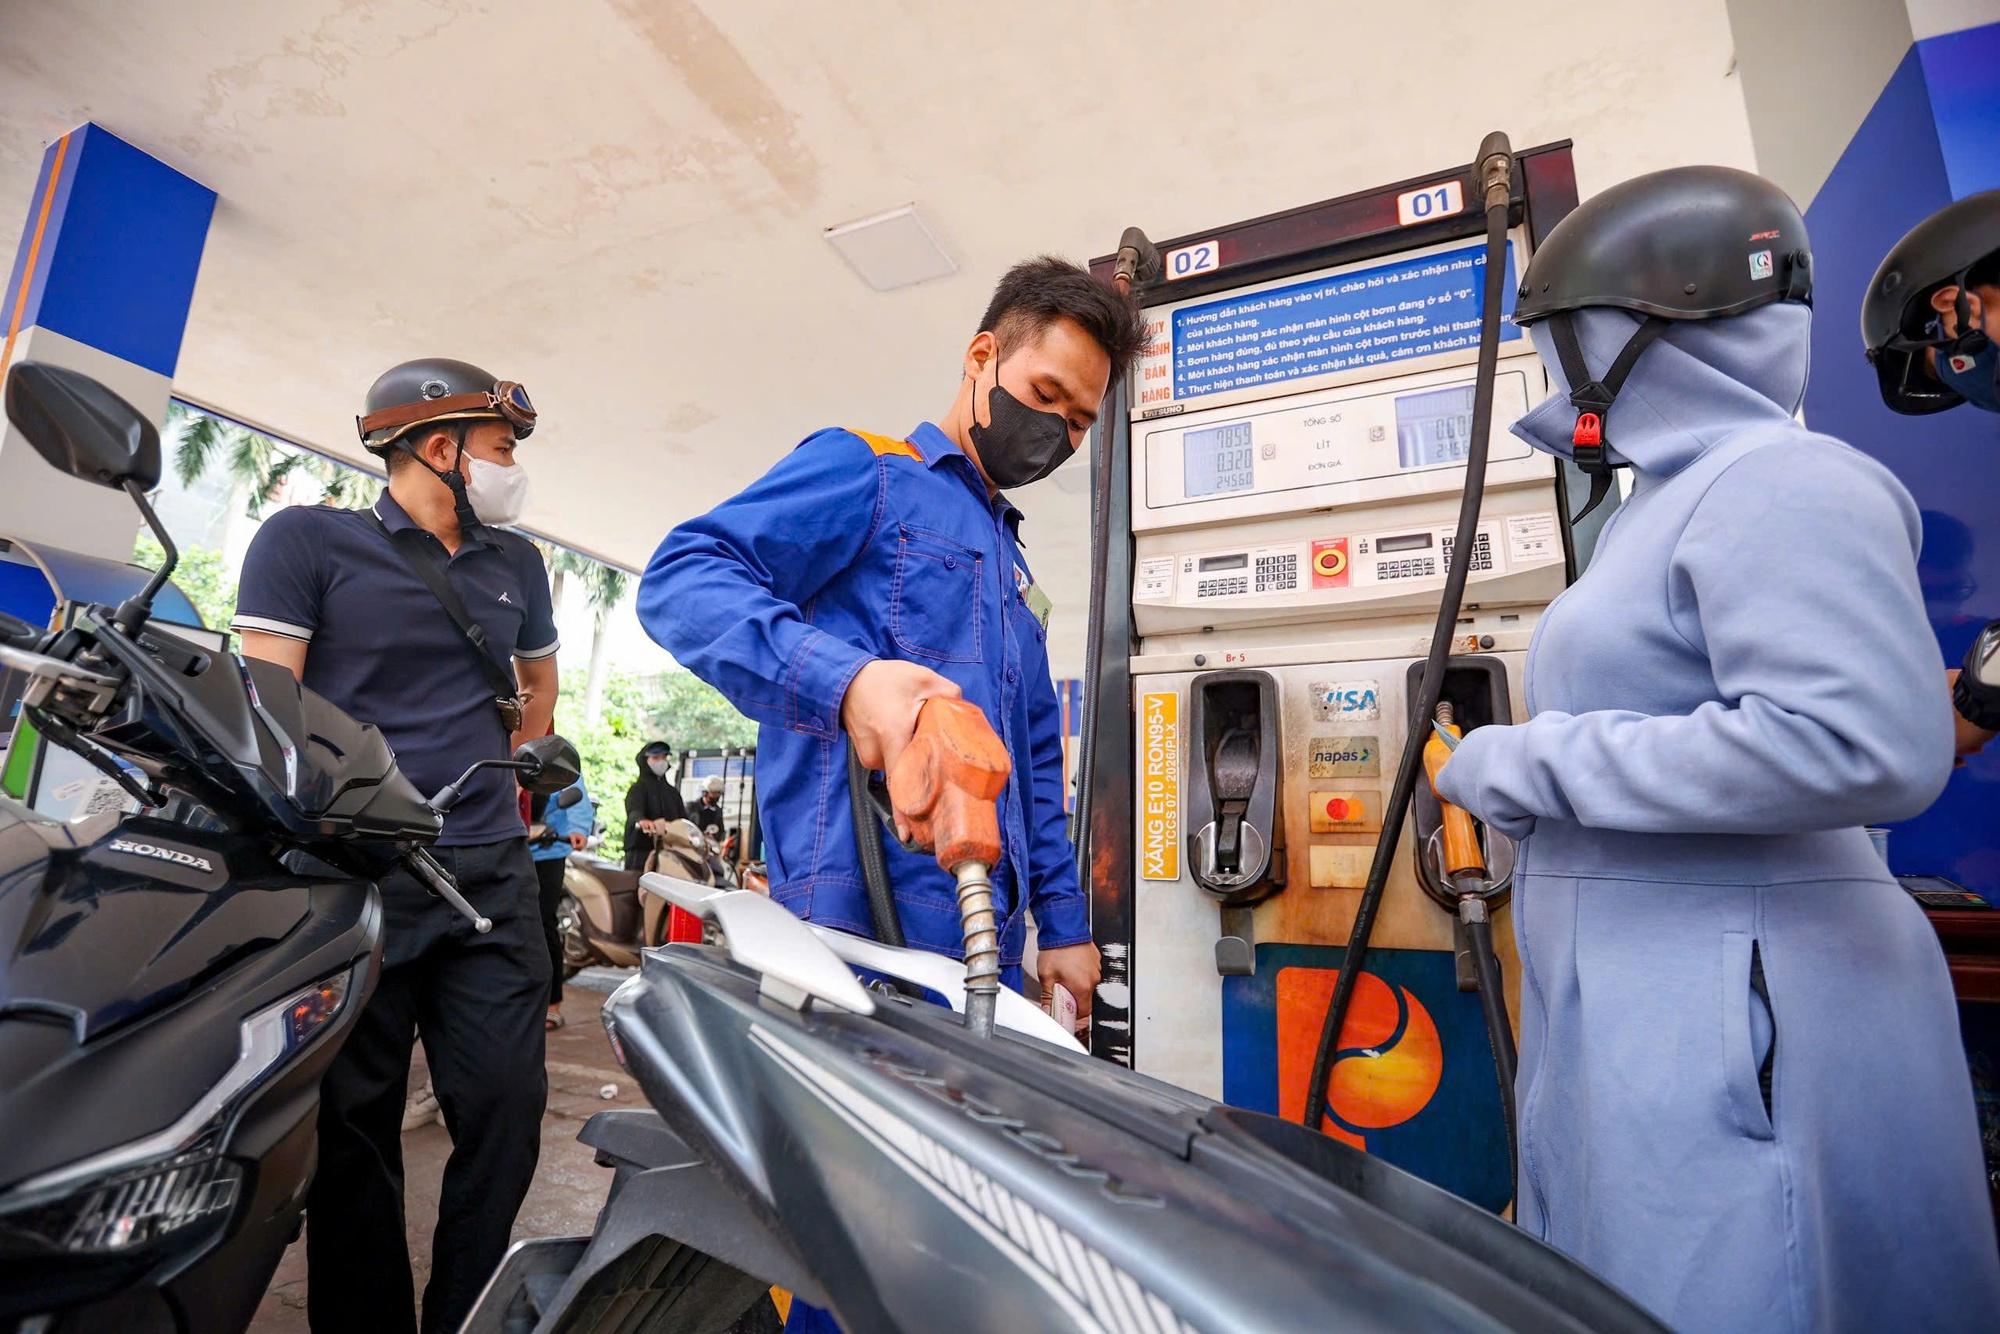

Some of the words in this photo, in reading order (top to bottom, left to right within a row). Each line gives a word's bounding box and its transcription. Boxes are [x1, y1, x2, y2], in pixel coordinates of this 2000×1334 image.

[1412, 188, 1449, 217] 01
[1175, 247, 1210, 274] 02
[1239, 302, 1266, 315] khách
[1451, 259, 1472, 270] nhu
[1474, 253, 1487, 264] cầ
[1205, 322, 1232, 335] khách
[1206, 337, 1233, 349] khách
[1279, 338, 1300, 348] theo
[1364, 320, 1394, 332] khách
[1207, 365, 1234, 377] khách
[1433, 324, 1450, 334] khi
[1236, 373, 1262, 385] thanh
[1434, 337, 1466, 350] khách
[1469, 333, 1481, 344] hà
[1144, 406, 1183, 417] TATSUNO
[1148, 696, 1164, 776] RON95-V
[1165, 723, 1176, 782] 2026/PLX
[1315, 751, 1358, 765] napas
[1148, 781, 1164, 814] E10
[1166, 793, 1176, 808] 07
[1166, 810, 1176, 848] TCCS
[109, 839, 214, 872] HONDA
[1145, 820, 1164, 875] XĂNG
